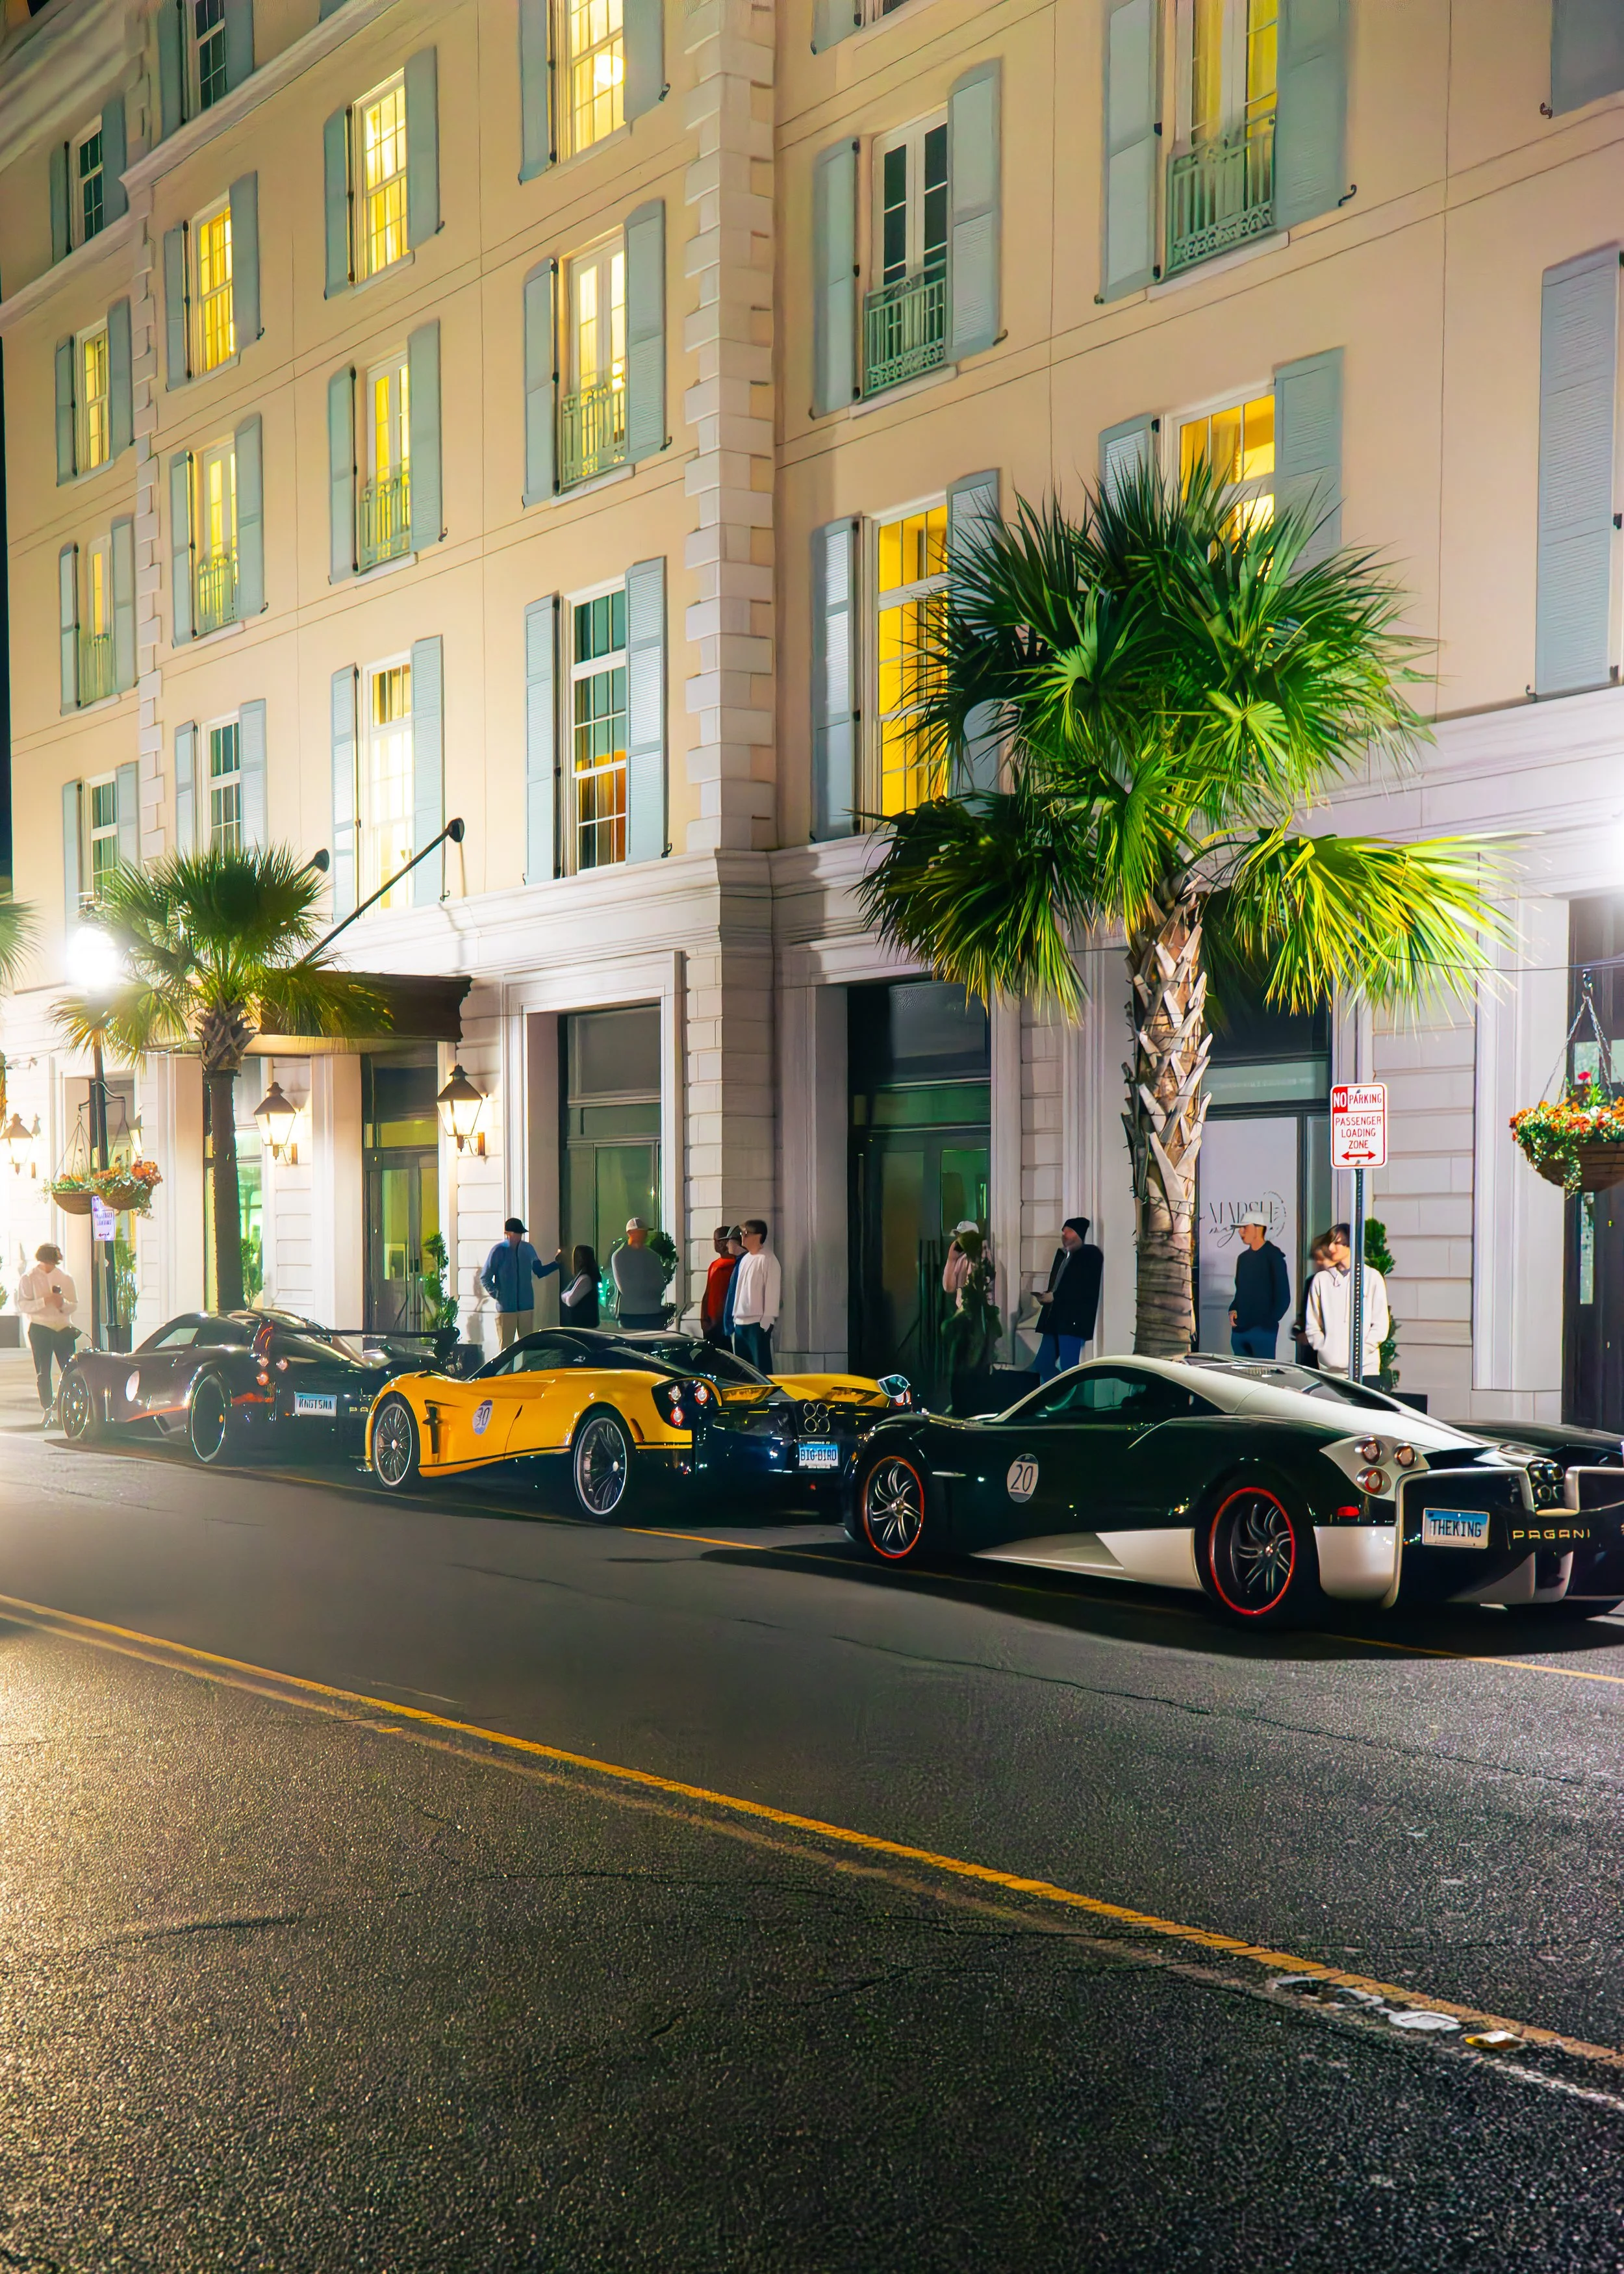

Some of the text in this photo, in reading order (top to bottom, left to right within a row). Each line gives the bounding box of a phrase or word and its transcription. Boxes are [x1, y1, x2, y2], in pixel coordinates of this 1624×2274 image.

[1333, 1092, 1382, 1108] NO PARKING
[1336, 1116, 1381, 1126] PASSENGER
[1341, 1128, 1376, 1138] LOADING
[1349, 1140, 1369, 1149] ZONE
[1011, 1464, 1033, 1492] 20
[1430, 1518, 1481, 1538] THEKING
[1512, 1529, 1590, 1539] PAGANI
